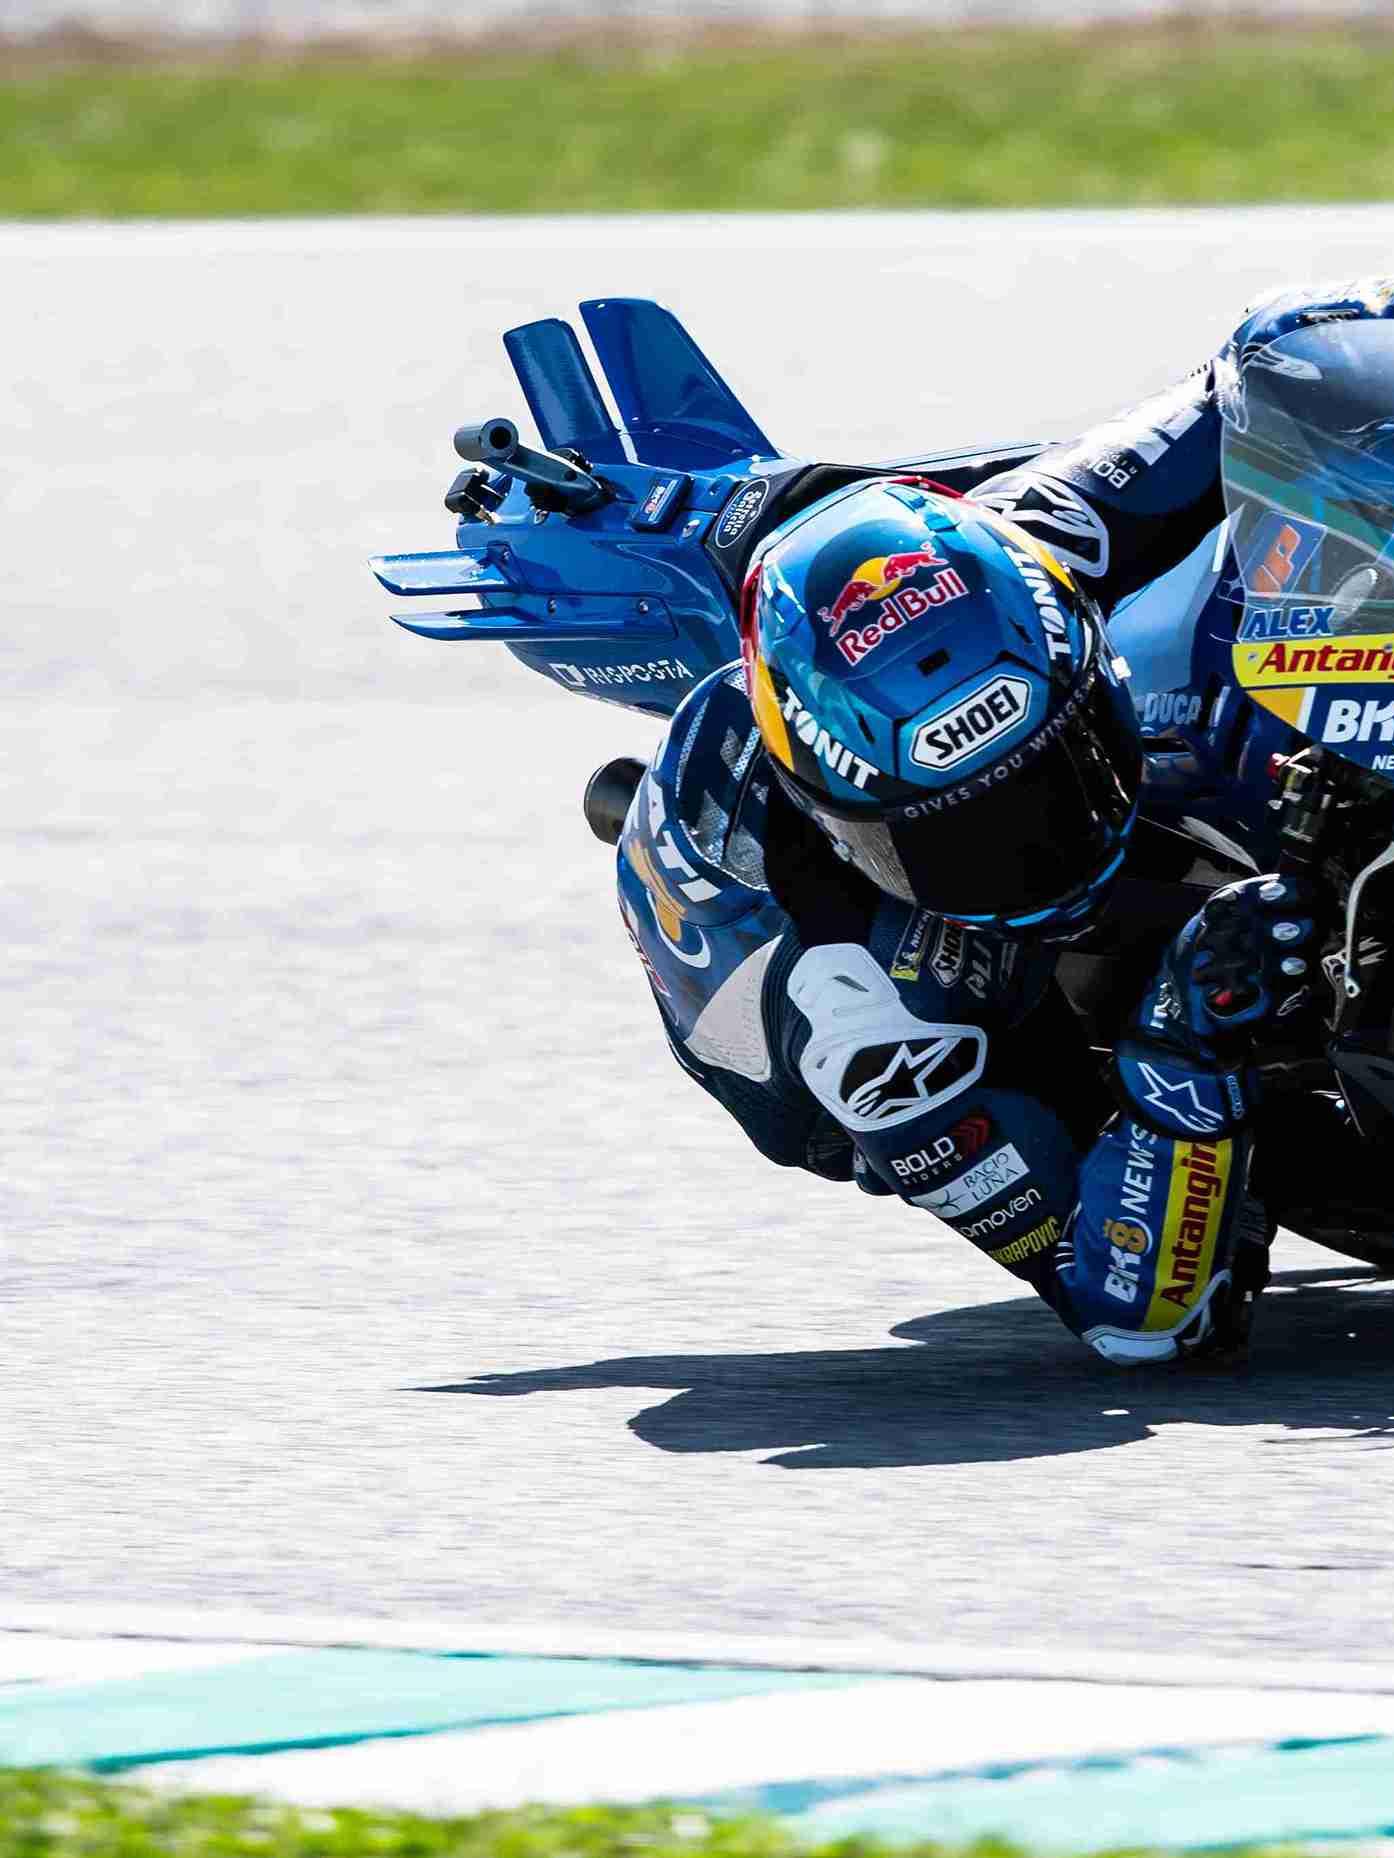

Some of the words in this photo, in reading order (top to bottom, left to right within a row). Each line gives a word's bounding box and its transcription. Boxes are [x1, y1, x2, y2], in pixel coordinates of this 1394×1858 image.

[836, 594, 906, 666] Red
[901, 568, 968, 622] Bull
[1003, 545, 1072, 662] TONIT
[1240, 607, 1335, 640] ALEX
[583, 658, 694, 685] RISPOSTA
[1142, 692, 1201, 724] DUCA
[780, 687, 880, 790] TONIT
[925, 684, 1020, 760] SHOEI
[904, 786, 969, 818] GIVES
[978, 754, 1023, 787] YOU
[890, 1134, 956, 1177] BOLD
[972, 1167, 1019, 1203] LUNA
[1121, 1123, 1157, 1215] NEWS
[1104, 1217, 1152, 1303] BK8
[1161, 1143, 1220, 1309] Antangin
